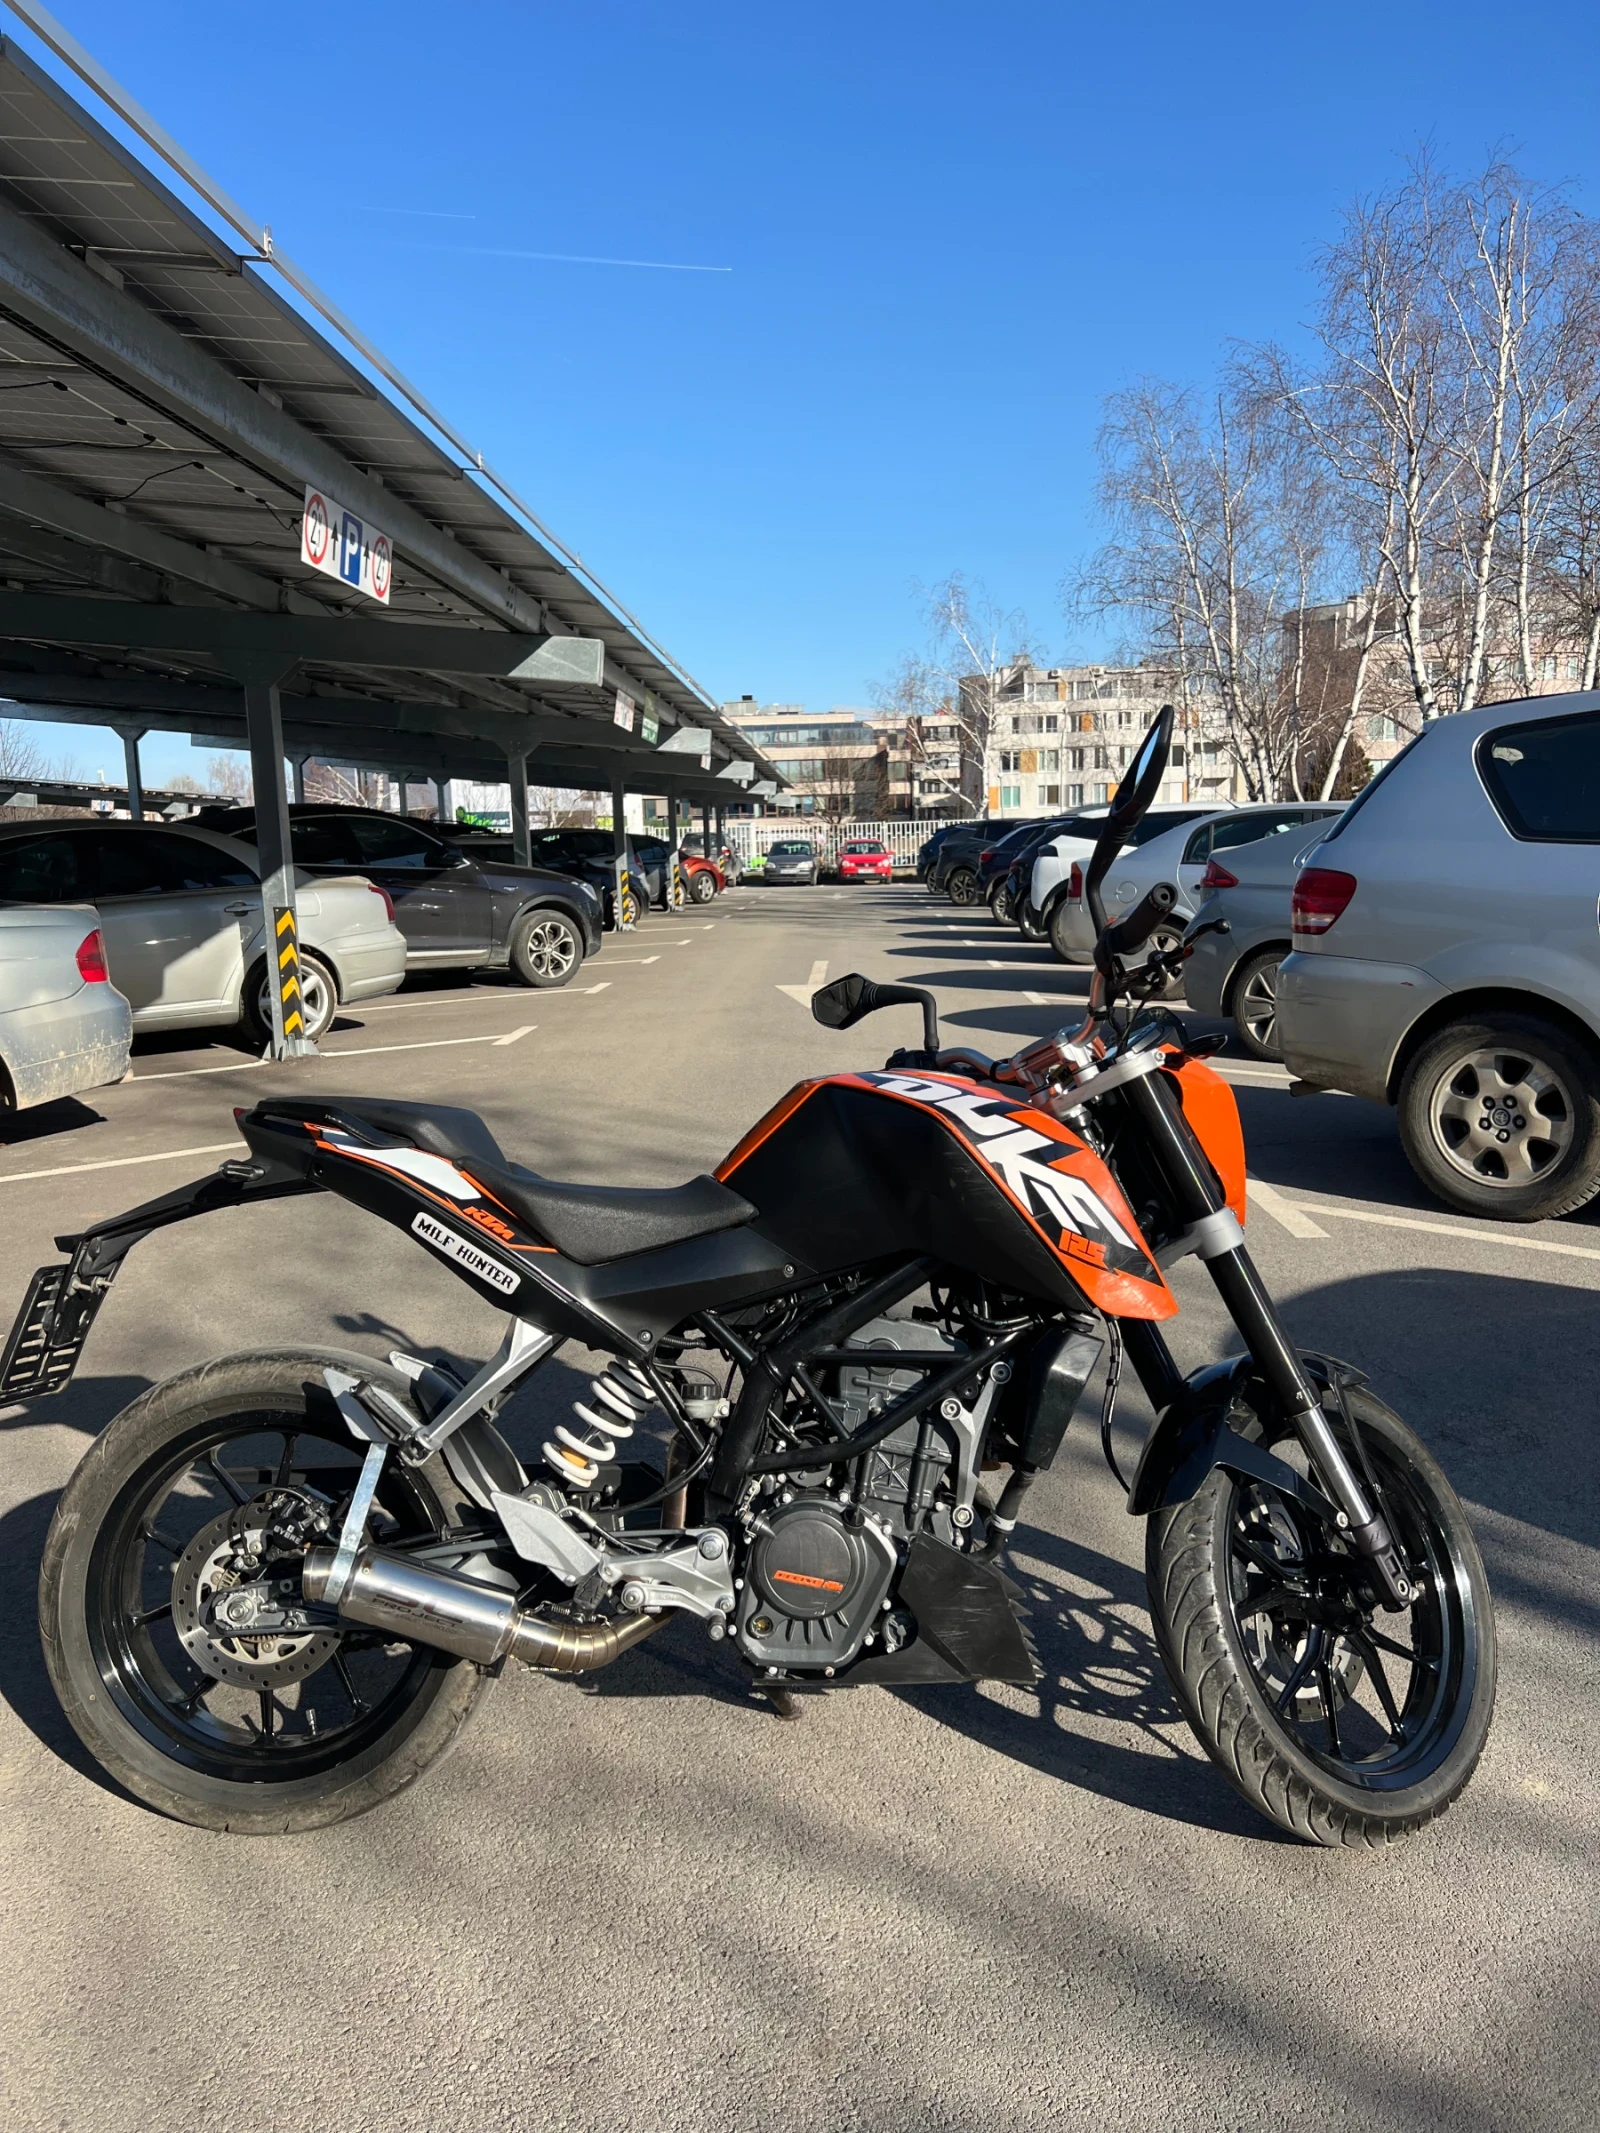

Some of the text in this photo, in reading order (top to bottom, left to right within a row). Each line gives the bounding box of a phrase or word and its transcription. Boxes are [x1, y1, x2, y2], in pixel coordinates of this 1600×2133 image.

[344, 521, 359, 576] P
[870, 1072, 1138, 1251] DUKE
[463, 1206, 515, 1241] KTM
[417, 1218, 514, 1290] MILF HUNTER
[1059, 1228, 1109, 1269] 125
[372, 1598, 458, 1628] PROJECT
